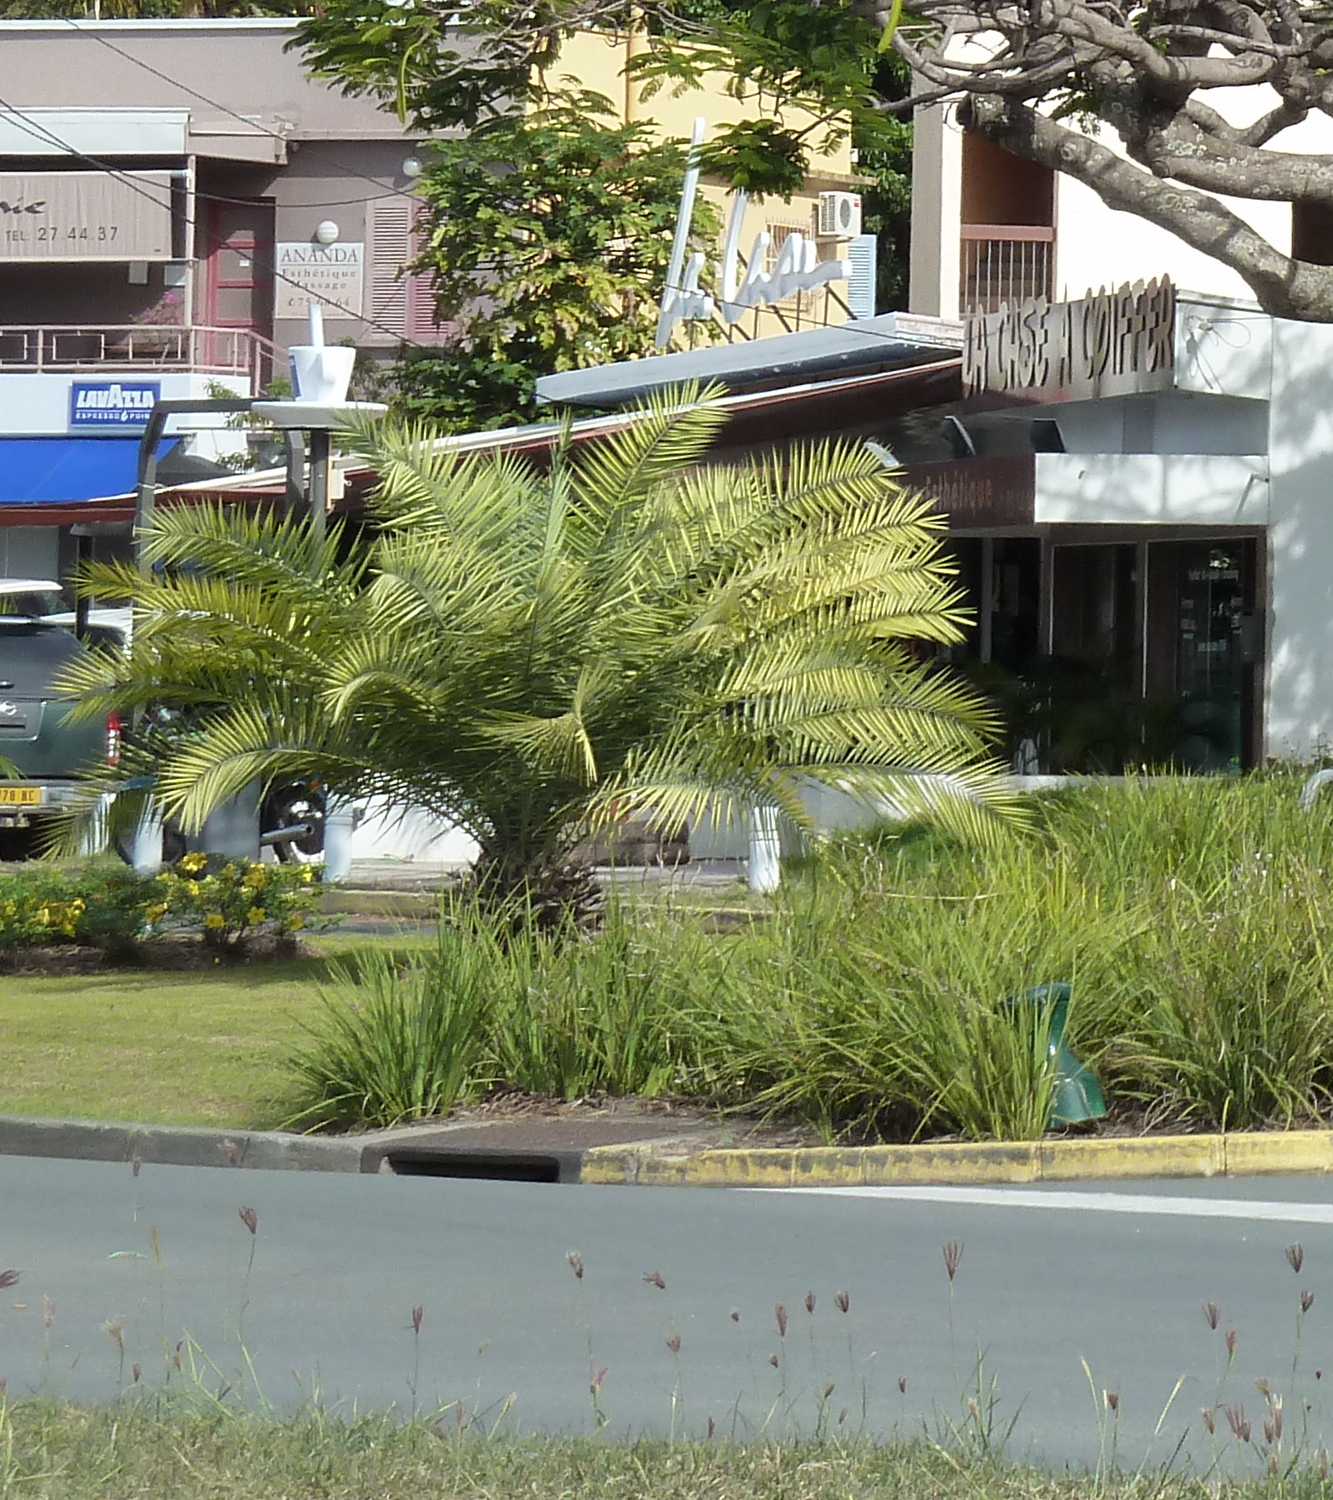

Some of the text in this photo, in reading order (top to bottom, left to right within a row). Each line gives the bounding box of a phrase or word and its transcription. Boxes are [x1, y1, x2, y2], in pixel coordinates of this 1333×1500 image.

[281, 249, 358, 263] ANANDA
[282, 268, 357, 280] Esthétique
[962, 304, 988, 399] LA
[996, 295, 1050, 391] CASE
[1083, 273, 1175, 380] COIFFER
[76, 384, 155, 408] LAVAZZA
[75, 412, 150, 420] ESPRESSO POIN
